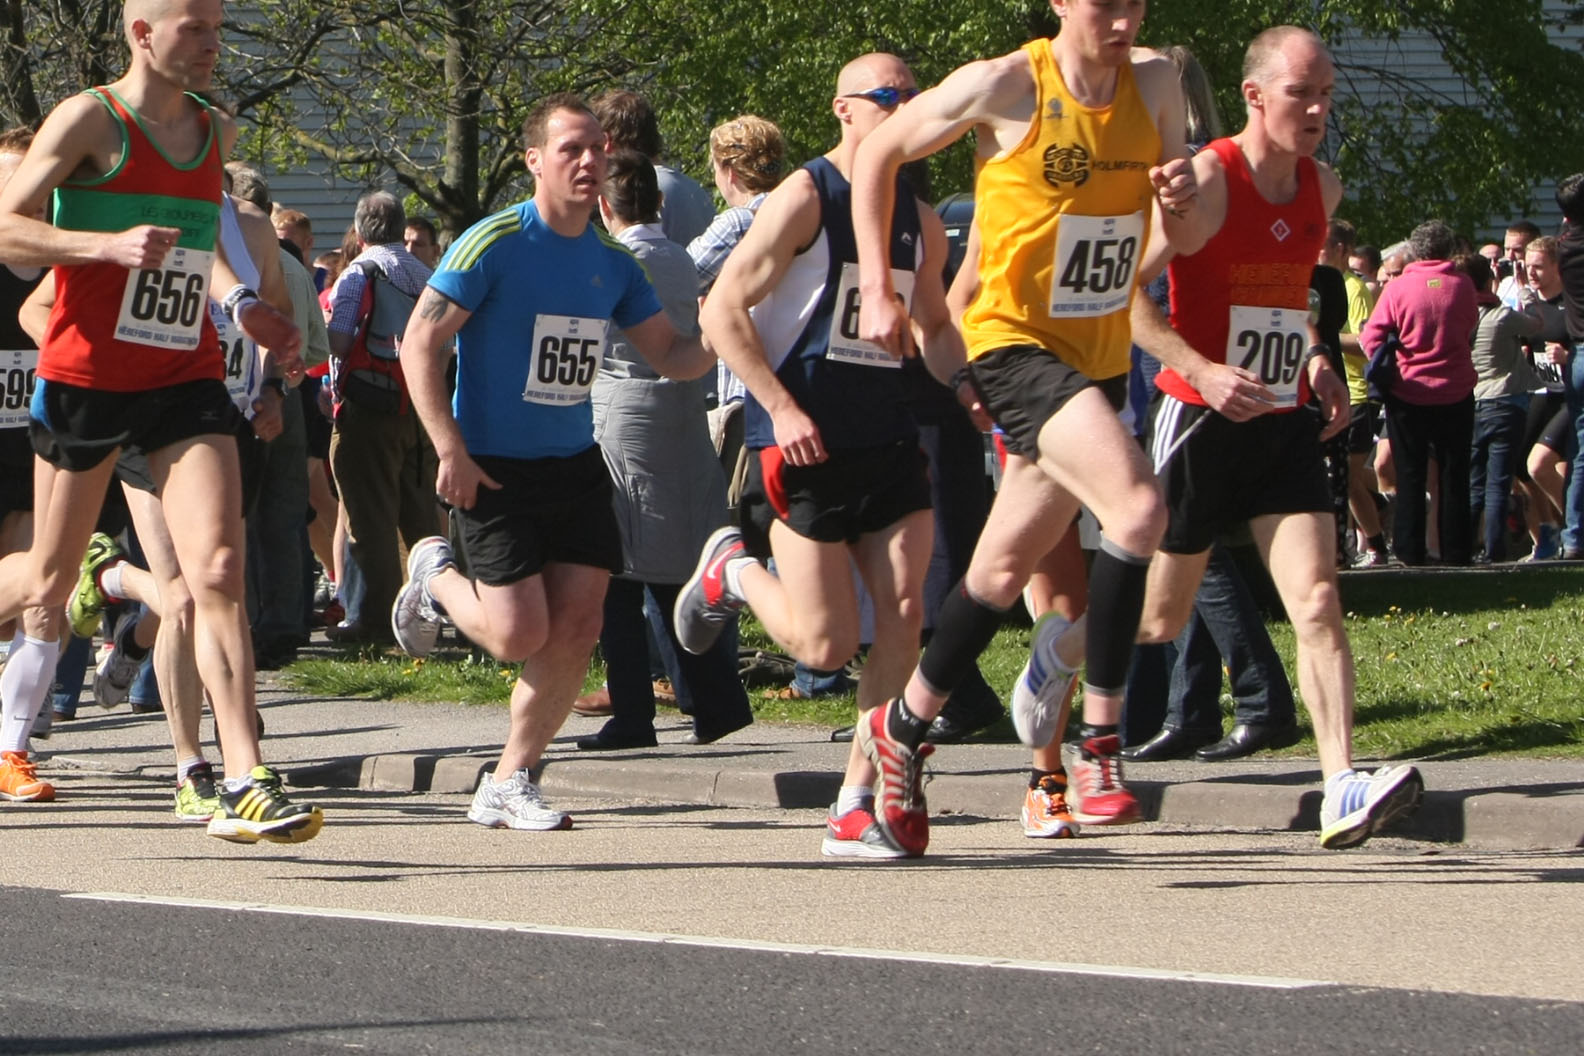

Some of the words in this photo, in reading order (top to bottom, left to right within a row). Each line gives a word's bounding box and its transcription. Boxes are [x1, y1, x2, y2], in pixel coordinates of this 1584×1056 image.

[1059, 236, 1137, 293] 458
[131, 269, 204, 327] 656
[537, 336, 599, 386] 655
[1236, 330, 1304, 385] 209
